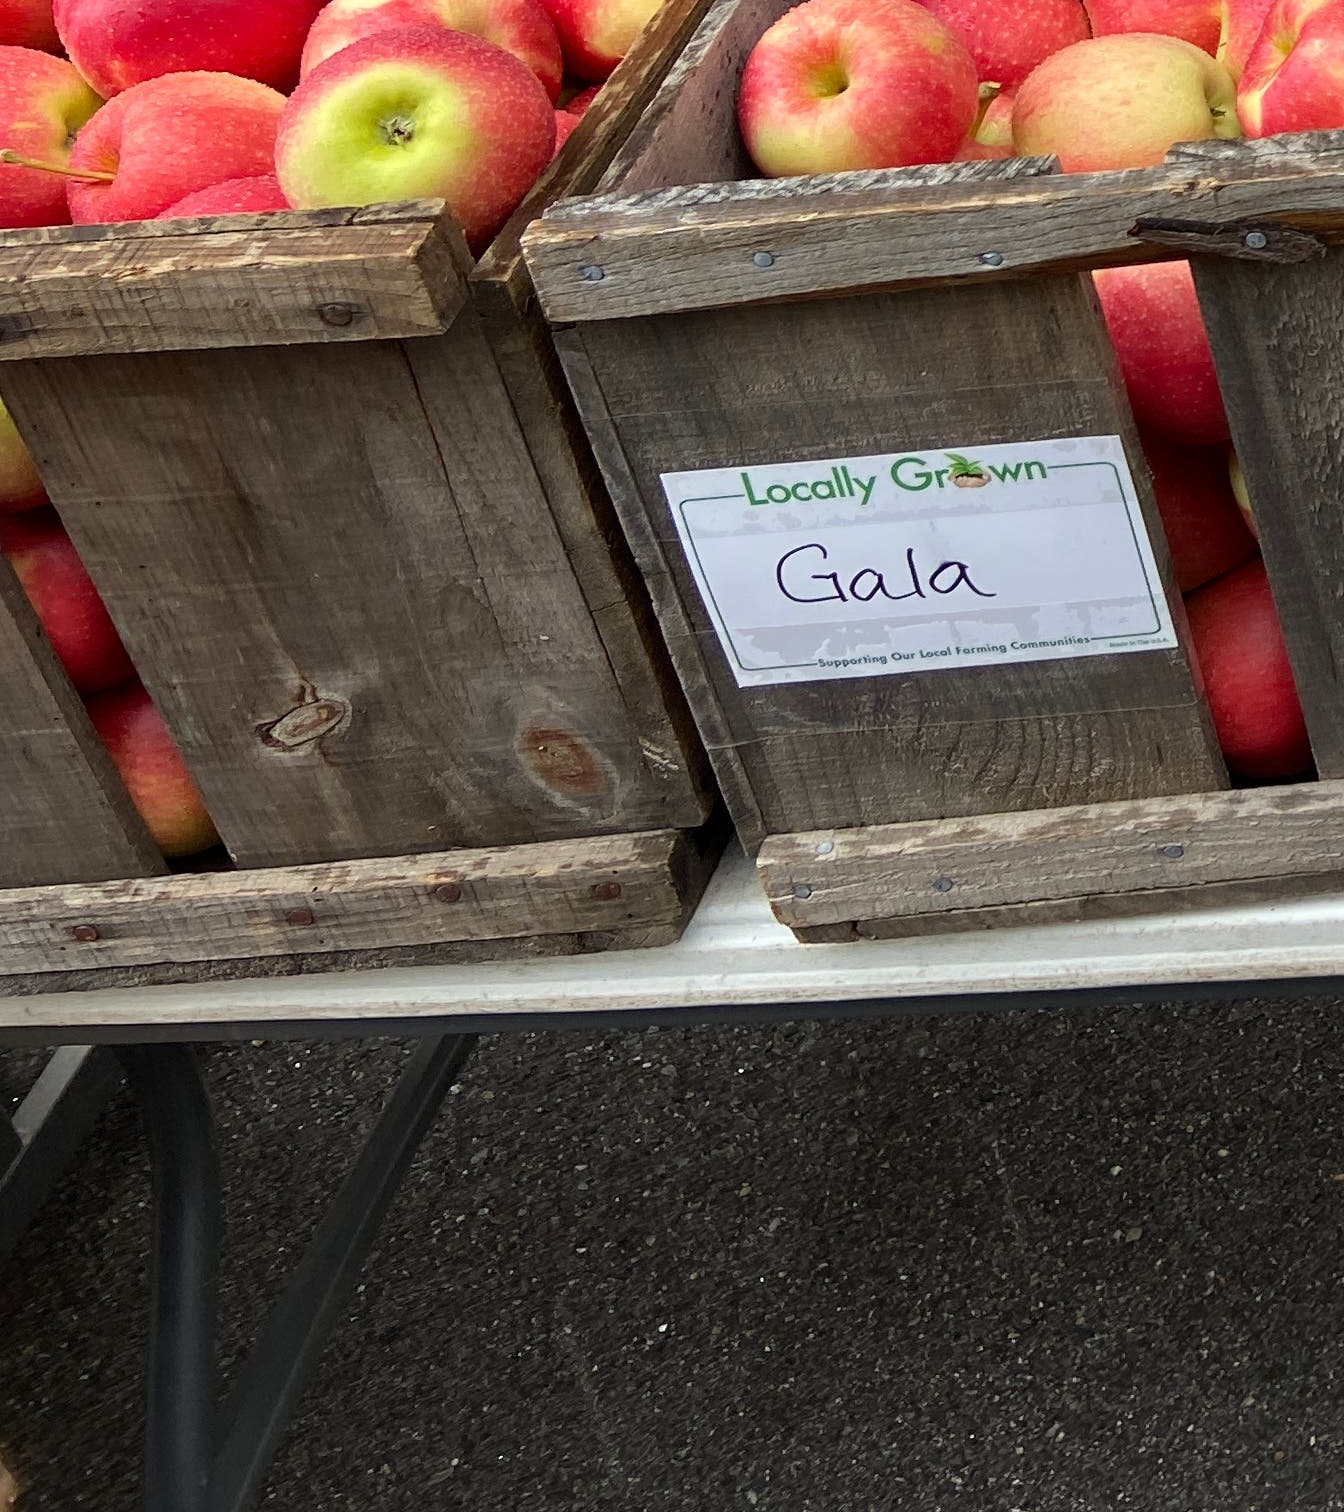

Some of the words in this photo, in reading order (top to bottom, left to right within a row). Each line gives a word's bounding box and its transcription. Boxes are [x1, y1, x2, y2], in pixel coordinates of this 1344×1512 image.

[740, 465, 877, 507] Locally
[776, 543, 997, 603] Gala
[818, 652, 888, 669] Supporting
[891, 651, 915, 661] Our
[919, 647, 952, 659] Local
[956, 643, 1008, 656] Farming
[1010, 635, 1091, 651] Communities
